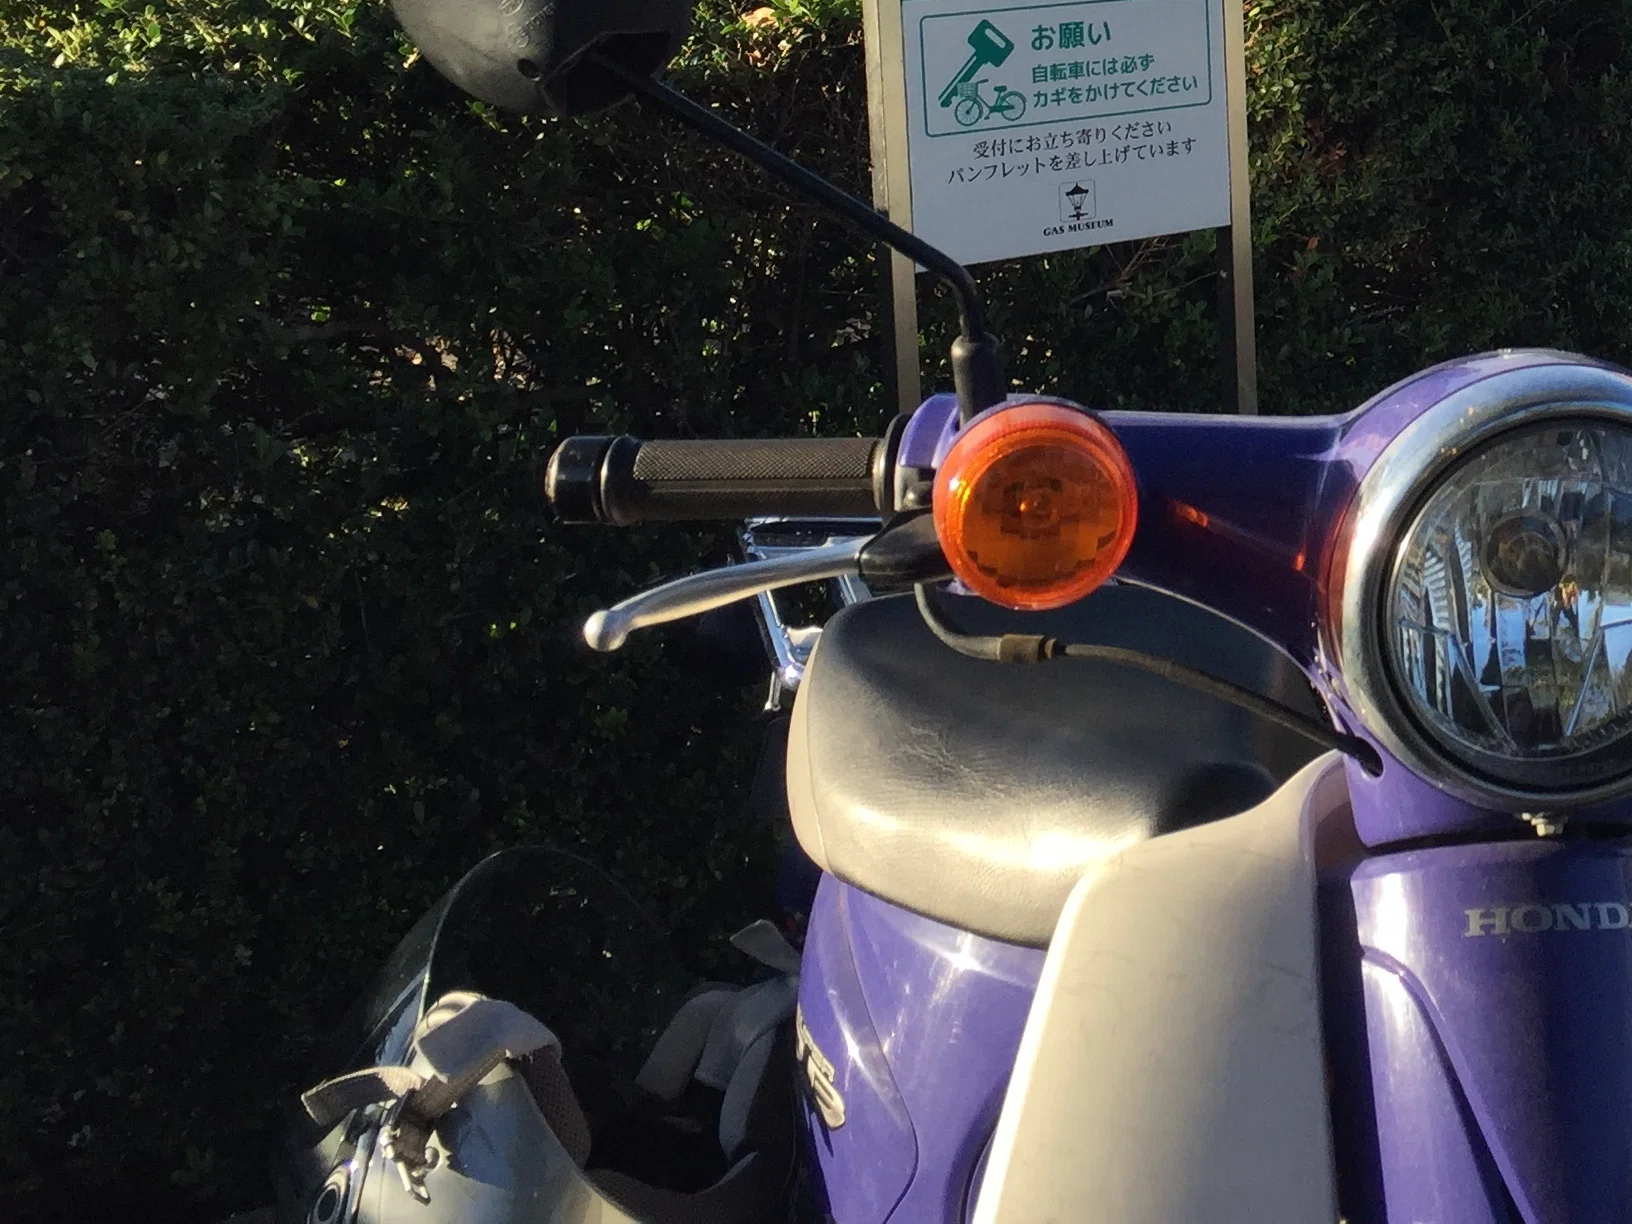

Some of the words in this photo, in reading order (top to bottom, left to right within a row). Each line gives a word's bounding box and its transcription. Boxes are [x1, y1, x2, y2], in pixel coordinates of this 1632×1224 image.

[1030, 20, 1112, 51] お願い
[1031, 53, 1155, 84] 自転車には必ず
[1033, 75, 1199, 108] カギをかけてください
[973, 120, 1173, 161] 受付にお立ち寄りください
[947, 136, 1198, 185] パンフレットを差し上げています
[1042, 225, 1065, 237] GAS
[1067, 218, 1114, 233] MUSEUM
